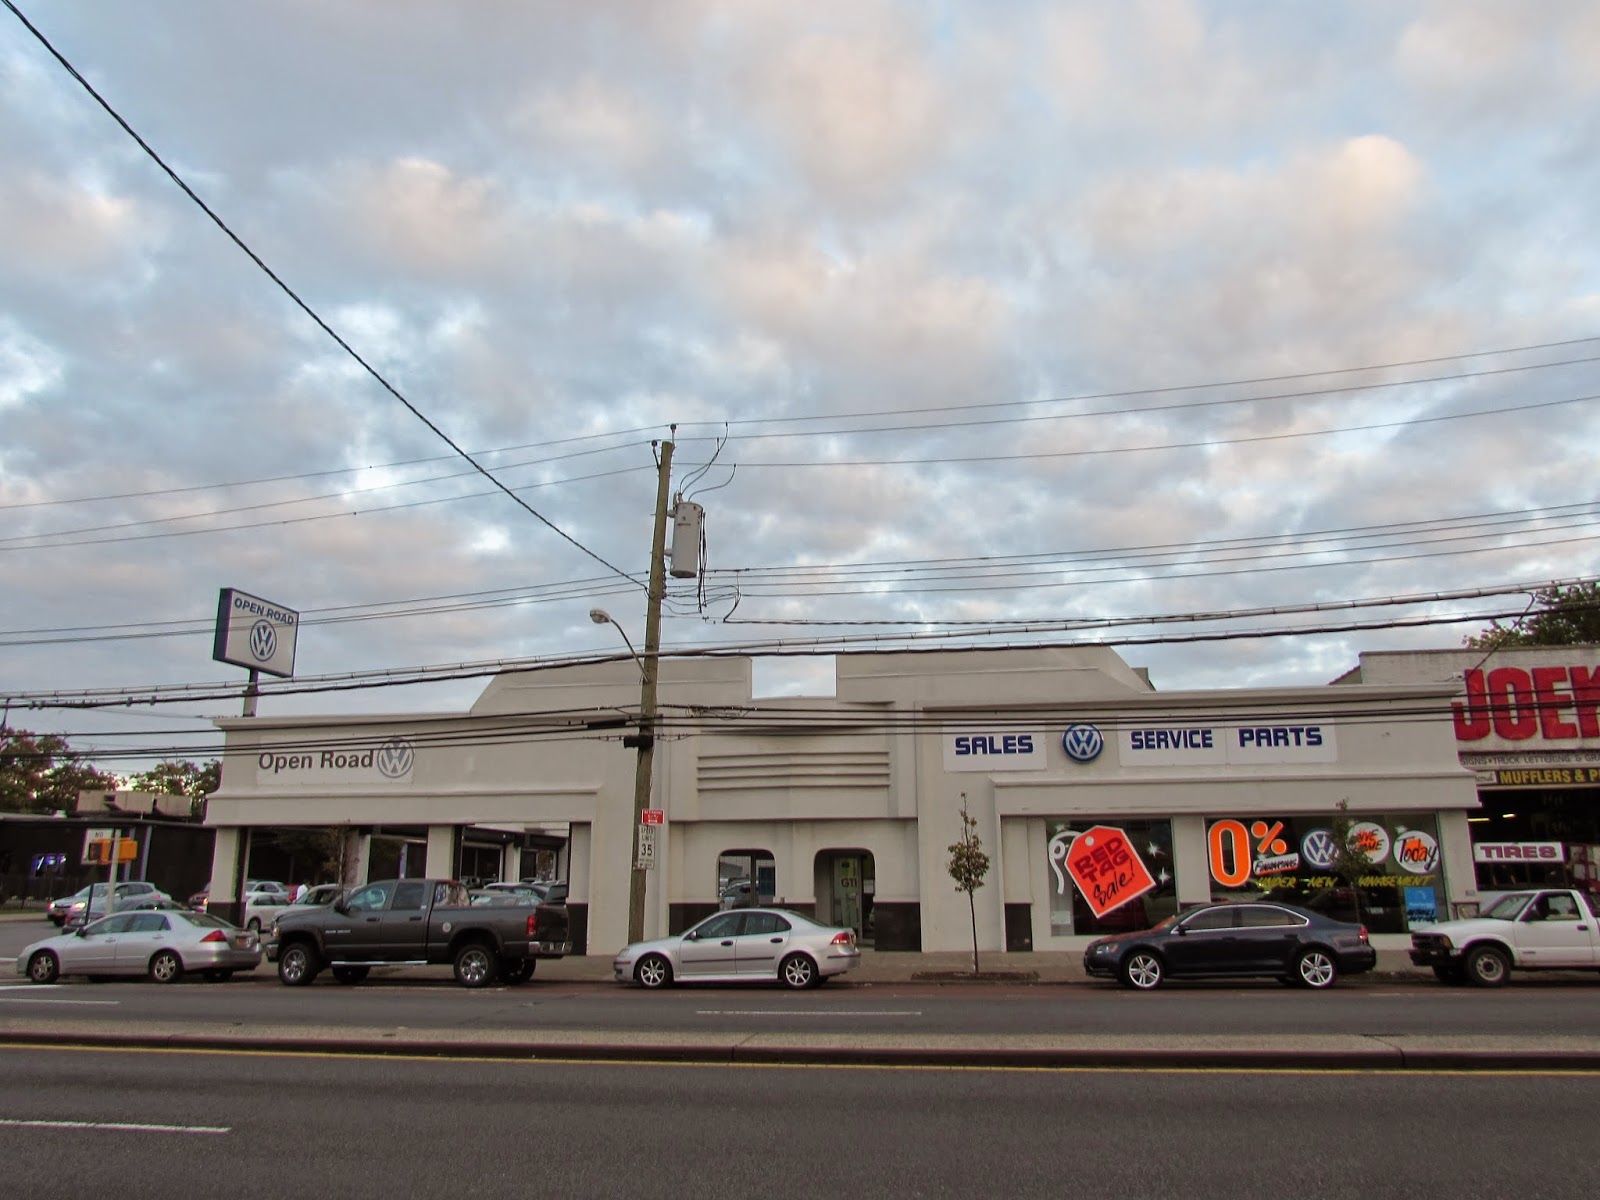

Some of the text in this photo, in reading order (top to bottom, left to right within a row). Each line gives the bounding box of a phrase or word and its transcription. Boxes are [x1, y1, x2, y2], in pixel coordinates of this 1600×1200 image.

[234, 597, 295, 625] OPEN ROAD
[955, 735, 1034, 755] SALES
[1130, 729, 1213, 750] SERVICE
[1238, 727, 1322, 747] PARTS
[258, 749, 375, 774] Open Road
[1493, 756, 1520, 764] TRUCK
[1499, 769, 1571, 784] MUFFLERS
[1574, 769, 1585, 783] &
[1589, 768, 1600, 782] P
[641, 843, 653, 856] 35
[1074, 837, 1122, 874] RED
[1208, 819, 1287, 888] 0%
[1395, 836, 1438, 871] Today
[1480, 845, 1557, 859] TIRES
[1081, 849, 1131, 883] TAG
[841, 878, 857, 888] GTI
[1093, 858, 1135, 906] Sale!
[1257, 876, 1297, 888] UNDER
[1307, 876, 1338, 888] NEW
